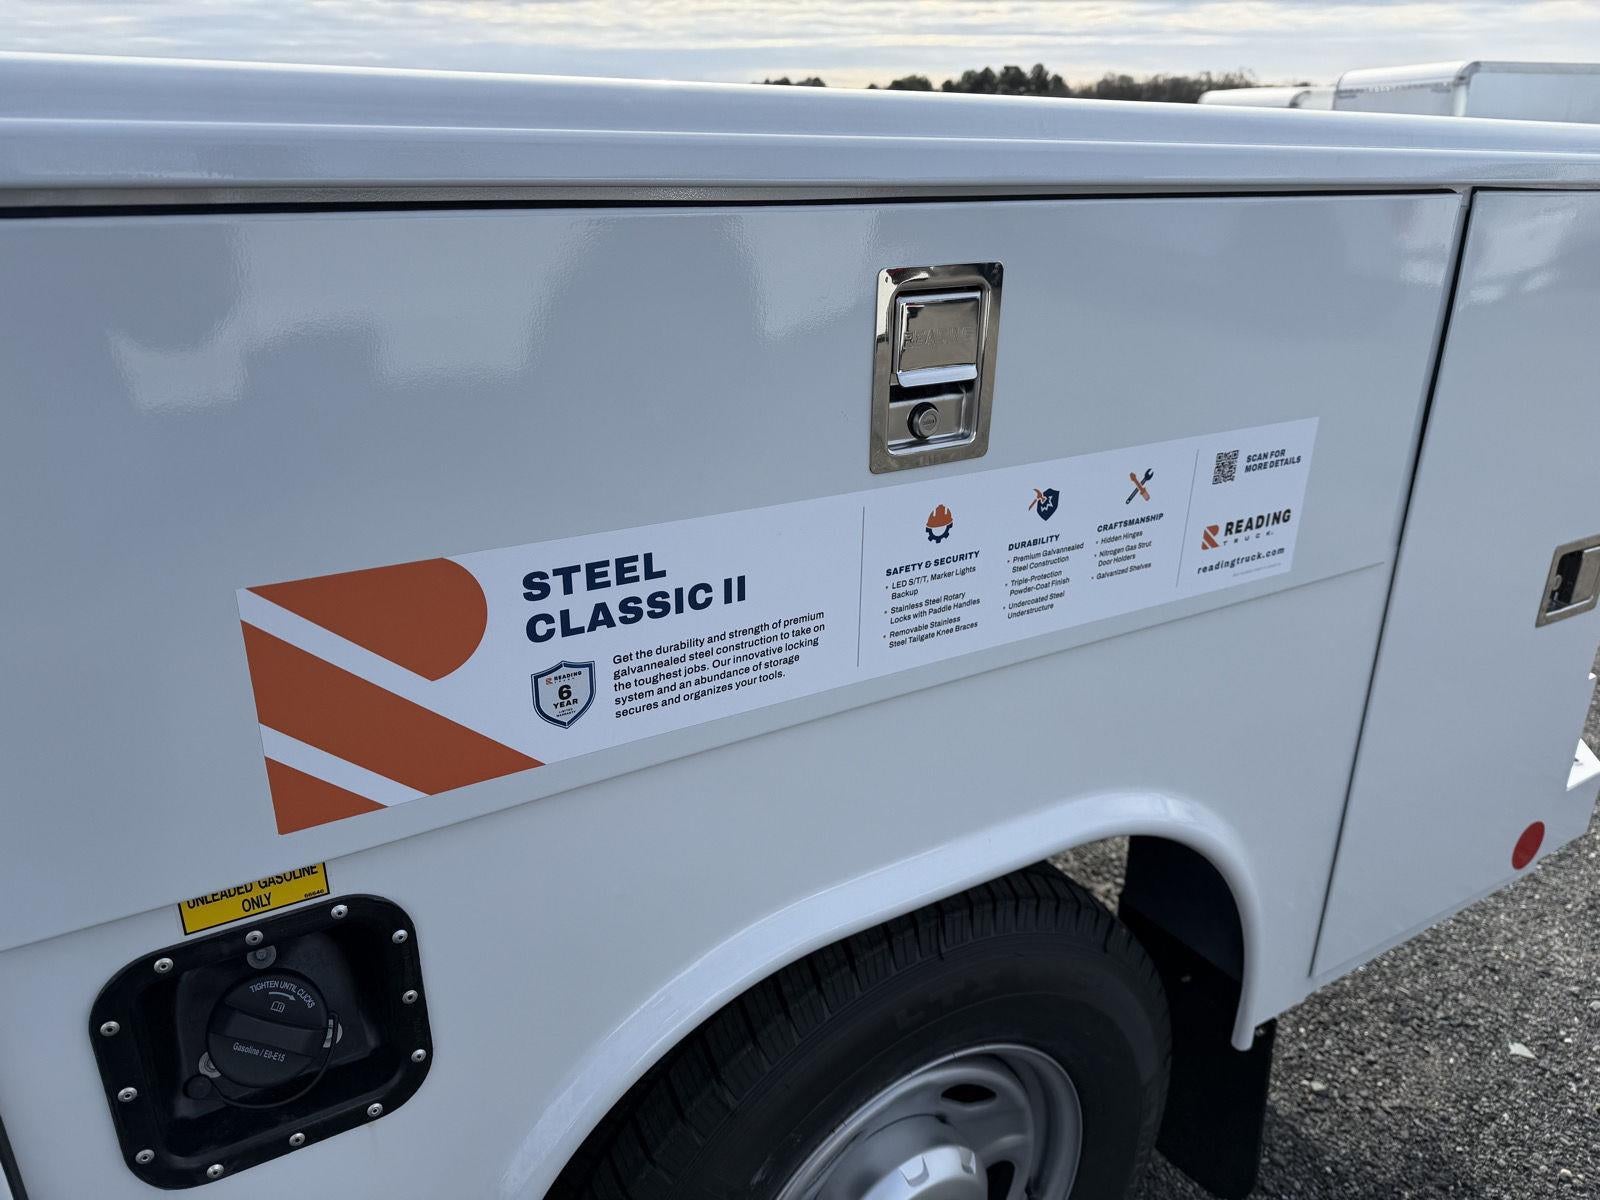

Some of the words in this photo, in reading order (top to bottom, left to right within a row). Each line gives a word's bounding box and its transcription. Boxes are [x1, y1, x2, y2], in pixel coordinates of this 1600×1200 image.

[1244, 462, 1268, 473] MORE
[1268, 456, 1302, 469] DETAILS
[1246, 452, 1268, 463] SCAN
[1270, 449, 1286, 458] FOR
[1096, 512, 1164, 532] CRAFTSMANSHIP
[1224, 508, 1292, 537] READING
[1008, 534, 1060, 552] DURABILITY
[1100, 535, 1122, 544] Hidden
[1122, 530, 1144, 540] Hinges
[1012, 552, 1042, 564] Premium
[1042, 542, 1084, 557] Galvannealed
[1099, 547, 1124, 558] Nitrogen
[1125, 544, 1137, 552] Gas
[1138, 540, 1152, 550] Strut
[886, 562, 924, 576] SAFETY
[924, 560, 932, 568] &
[933, 550, 980, 567] SECURITY
[1012, 564, 1028, 574] Steel
[1030, 555, 1070, 570] Construction
[1096, 568, 1128, 580] Galvanized
[1129, 562, 1152, 572] Shelves
[1098, 559, 1113, 567] Door
[1114, 554, 1136, 564] Holders
[1197, 547, 1285, 575] readingtruck.com
[522, 552, 667, 602] STEEL
[892, 580, 907, 590] LED
[908, 576, 930, 586] S/T/T,
[930, 570, 954, 582] Marker
[955, 566, 976, 576] Lights
[1010, 570, 1062, 587] Triple-Protection
[1010, 582, 1050, 596] Powder-Coat
[1052, 576, 1070, 586] Finish
[890, 602, 923, 614] Stainless
[924, 596, 942, 607] Steel
[944, 592, 966, 603] Rotary
[891, 588, 918, 600] Backup
[1008, 594, 1048, 610] Undercoated
[1049, 590, 1066, 600] Steel
[525, 582, 713, 643] CLASSIC
[723, 575, 746, 605] II
[890, 613, 912, 624] Locks
[912, 610, 927, 619] with
[928, 605, 952, 616] Paddle
[953, 598, 981, 610] Handles
[1008, 603, 1054, 619] Understructure
[612, 652, 633, 664] Get
[636, 649, 653, 660] the
[655, 638, 705, 655] durability
[706, 632, 726, 644] and
[728, 622, 770, 640] strength
[772, 618, 782, 630] of
[783, 611, 824, 628] premium
[889, 638, 907, 649] Steel
[908, 632, 935, 644] Tailgate
[936, 626, 954, 637] Knee
[955, 621, 978, 632] Braces
[890, 624, 928, 639] Removable
[930, 616, 961, 629] Stainless
[613, 654, 686, 680] galvannealed
[688, 647, 714, 661] steel
[716, 634, 778, 655] construction
[780, 632, 790, 640] to
[792, 627, 812, 638] take
[814, 624, 825, 632] on
[614, 681, 632, 692] the
[634, 668, 682, 687] toughest
[684, 664, 710, 677] jobs.
[712, 658, 731, 668] Our
[732, 646, 783, 664] innovative
[785, 636, 819, 652] locking
[614, 689, 654, 706] system
[656, 682, 676, 695] and
[678, 680, 692, 690] an
[694, 666, 750, 686] abundance
[752, 662, 762, 672] of
[764, 654, 800, 670] storage
[558, 684, 572, 700] 6
[615, 702, 658, 718] secures
[661, 694, 681, 707] and
[683, 683, 733, 700] organizes
[735, 677, 757, 690] your
[759, 670, 786, 683] tools.
[553, 698, 578, 709] YEAR
[241, 892, 272, 913] ONLY
[250, 980, 279, 993] TIGHTEN
[280, 980, 297, 993] UNTIL
[296, 988, 316, 1009] CLICKS
[232, 1041, 260, 1056] Gasoline
[264, 1050, 286, 1062] E0-E15
